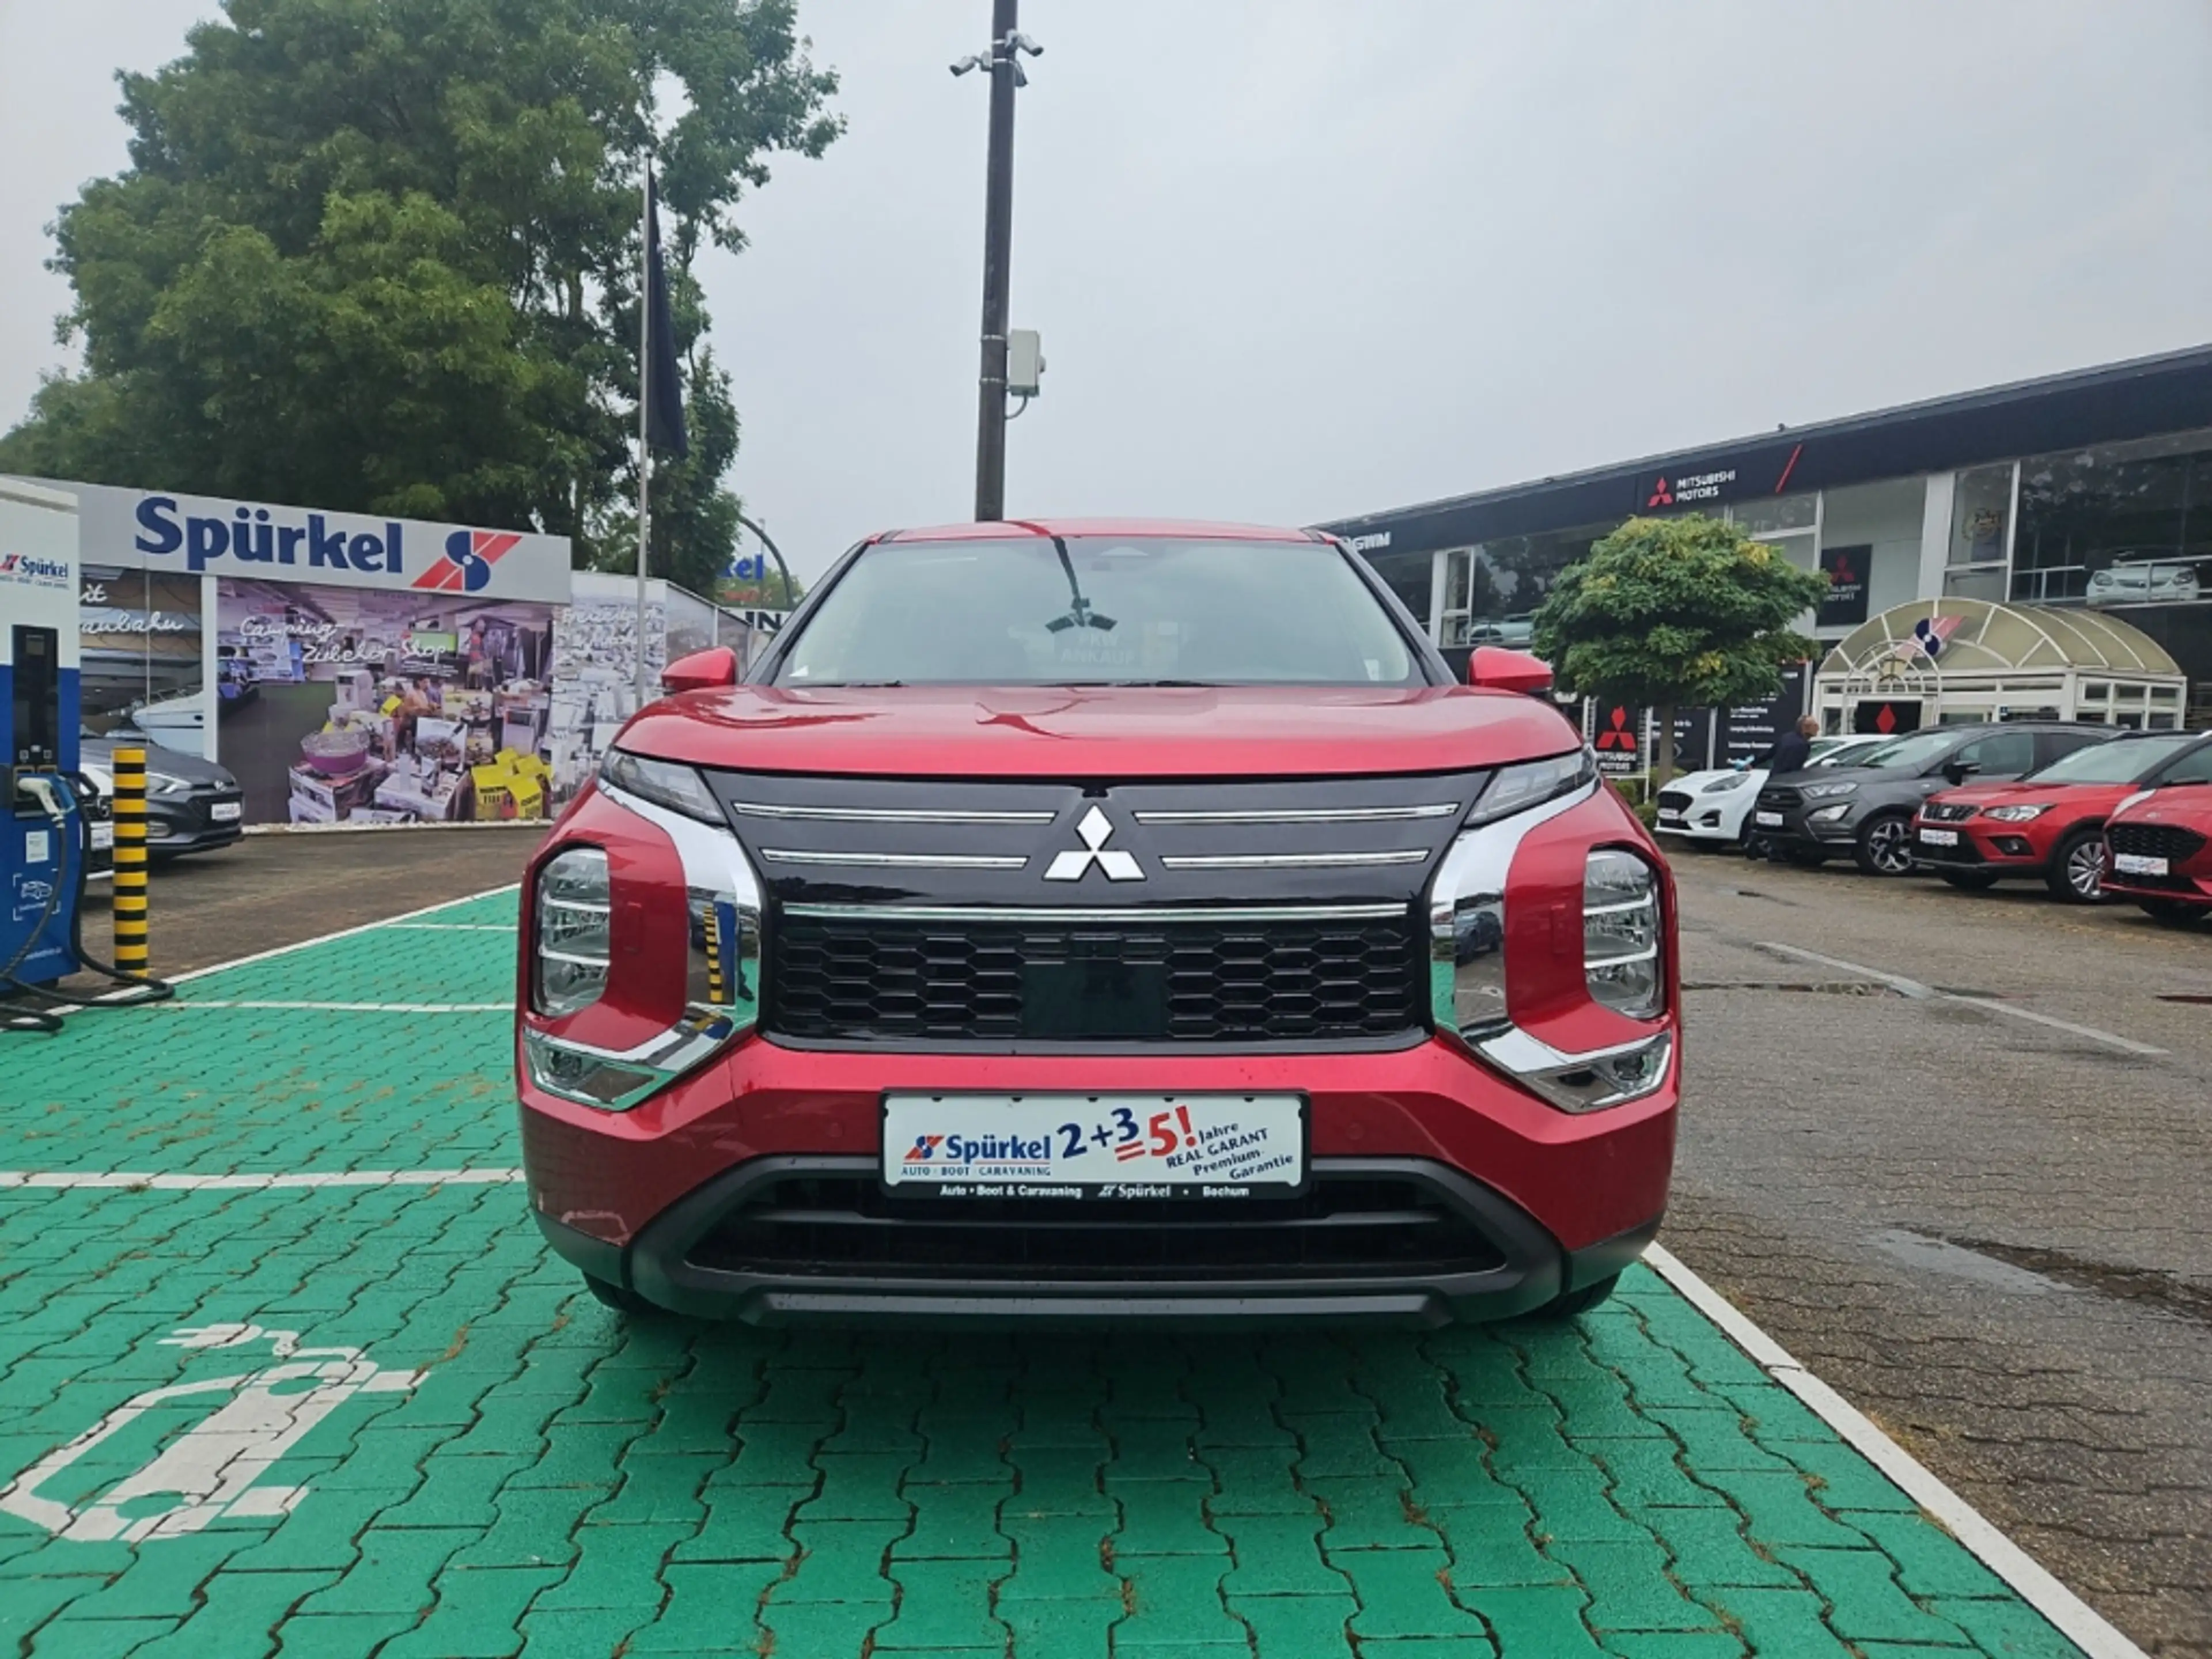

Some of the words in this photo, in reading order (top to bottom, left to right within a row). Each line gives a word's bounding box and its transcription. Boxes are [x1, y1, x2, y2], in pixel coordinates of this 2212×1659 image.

[1676, 469, 1736, 489] MITSUBISHI
[1676, 486, 1719, 502] MOTORS
[135, 497, 403, 574] Spürkel
[20, 555, 68, 578] Spürkel
[1198, 1123, 1238, 1144] Jahre
[946, 1135, 1051, 1164] Spürkel
[1166, 1149, 1204, 1168] REAL
[1207, 1127, 1269, 1156] GARANT
[902, 1166, 930, 1176] AUTO
[941, 1166, 970, 1176] BOOT
[979, 1166, 1051, 1176] CARAVANING
[1229, 1154, 1294, 1180] Garantie
[940, 1185, 967, 1196] Auto
[976, 1185, 1003, 1196] Boot
[1017, 1185, 1083, 1199] Caravaning
[1119, 1185, 1171, 1199] Spürkel
[1203, 1185, 1249, 1196] Bochum
